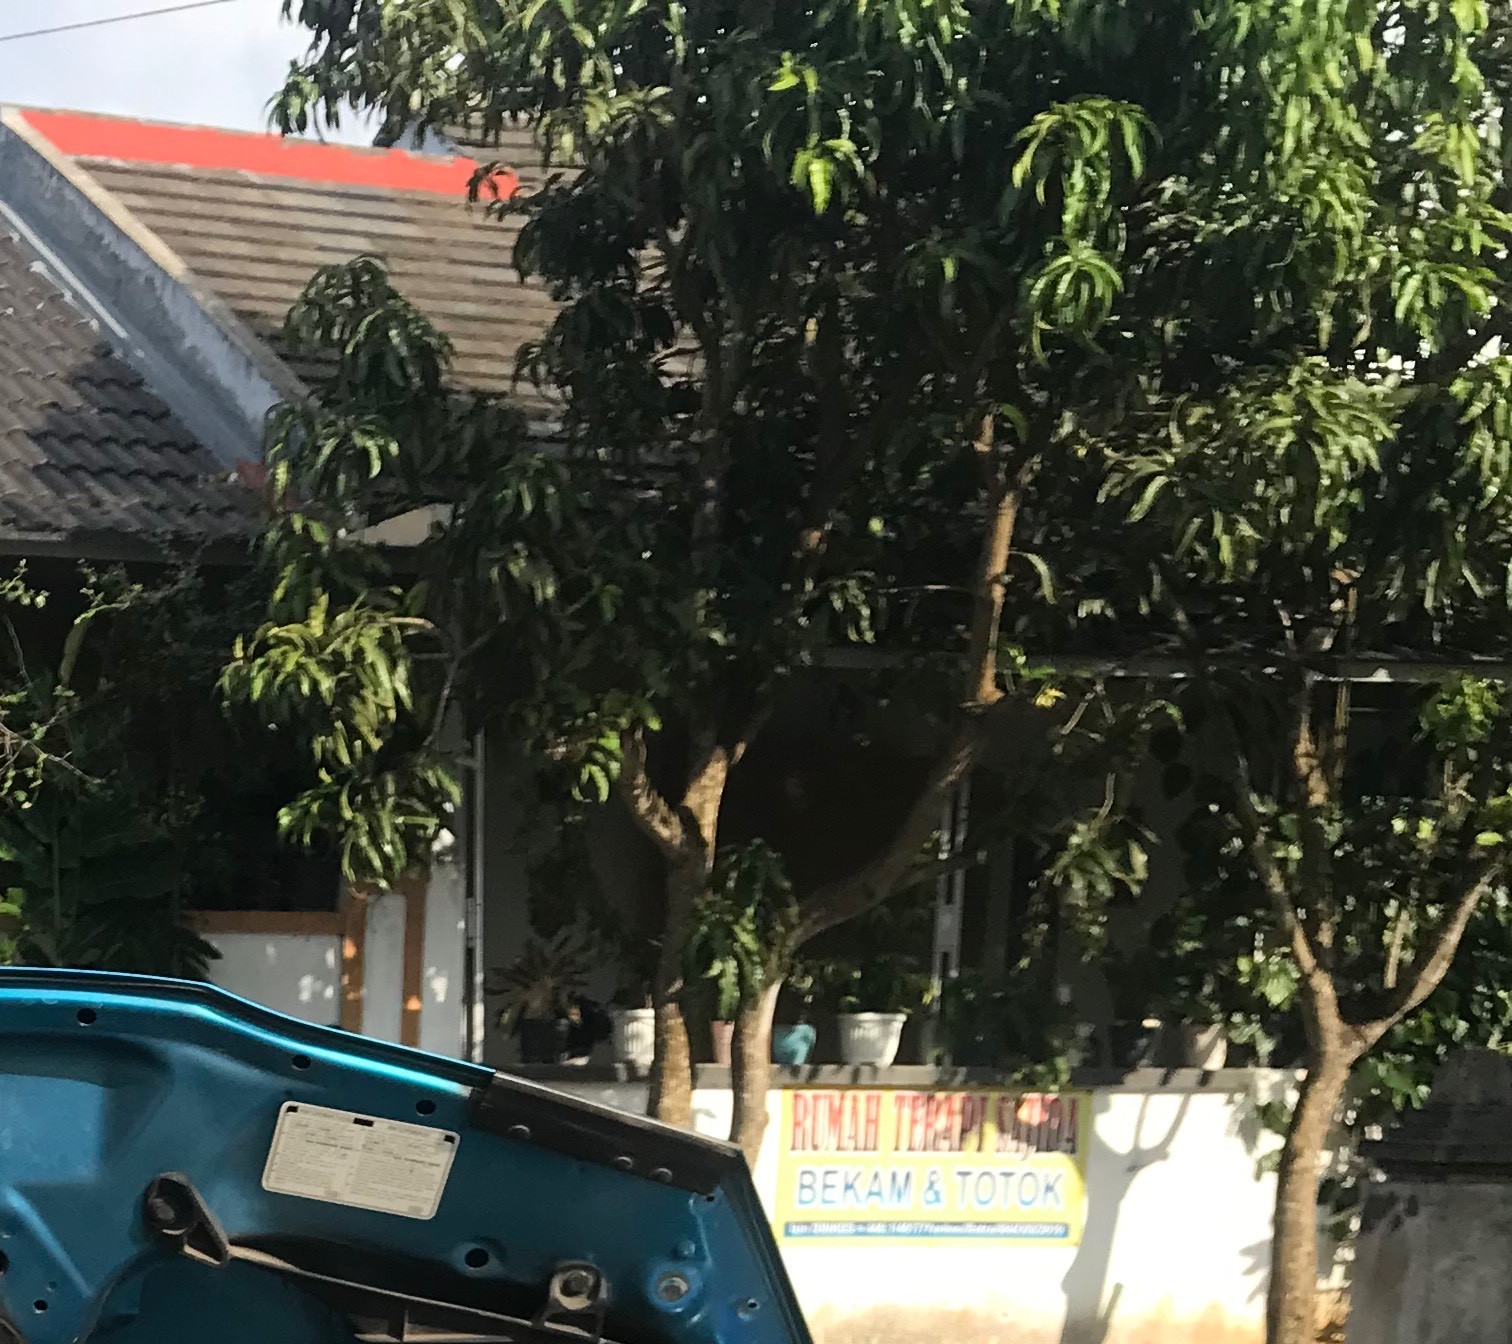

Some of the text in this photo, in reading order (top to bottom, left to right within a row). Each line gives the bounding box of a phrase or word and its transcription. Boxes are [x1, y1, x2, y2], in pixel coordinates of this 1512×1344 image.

[792, 1093, 883, 1151] RUMAH
[893, 1092, 989, 1151] TERAPI
[797, 1170, 1064, 1206] BEKAM & TOTOK
